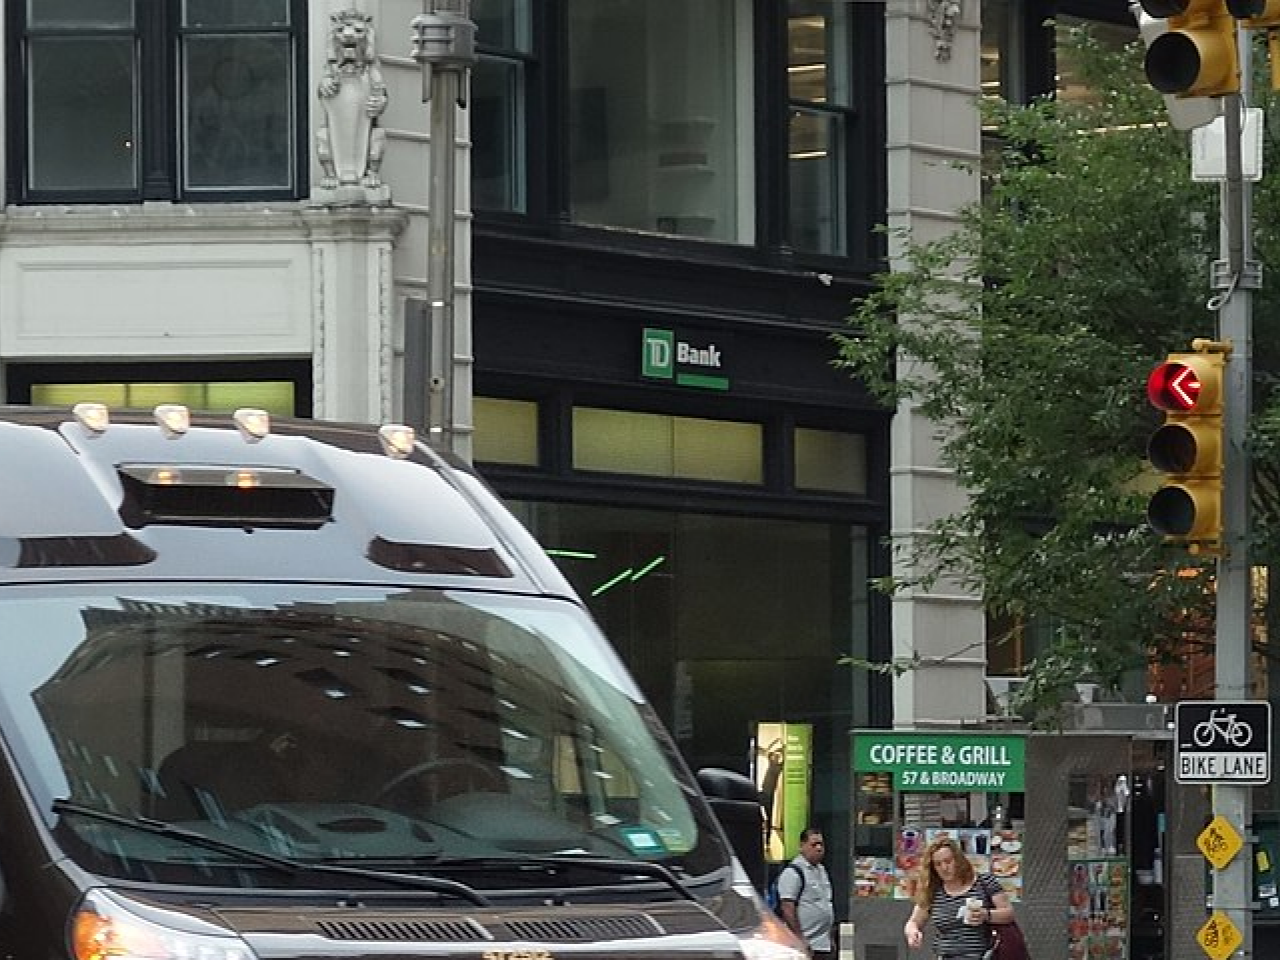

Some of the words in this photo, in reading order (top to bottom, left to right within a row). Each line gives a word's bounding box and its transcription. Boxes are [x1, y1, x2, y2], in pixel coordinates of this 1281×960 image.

[677, 342, 721, 367] Bank
[870, 744, 937, 765] COFFEE
[941, 745, 955, 765] &
[959, 745, 1011, 765] GRILL
[1182, 757, 1217, 775] BIKE
[1224, 757, 1264, 775] LANE
[902, 771, 918, 785] 57
[920, 772, 930, 785] &
[932, 772, 1006, 787] BROADWAY
